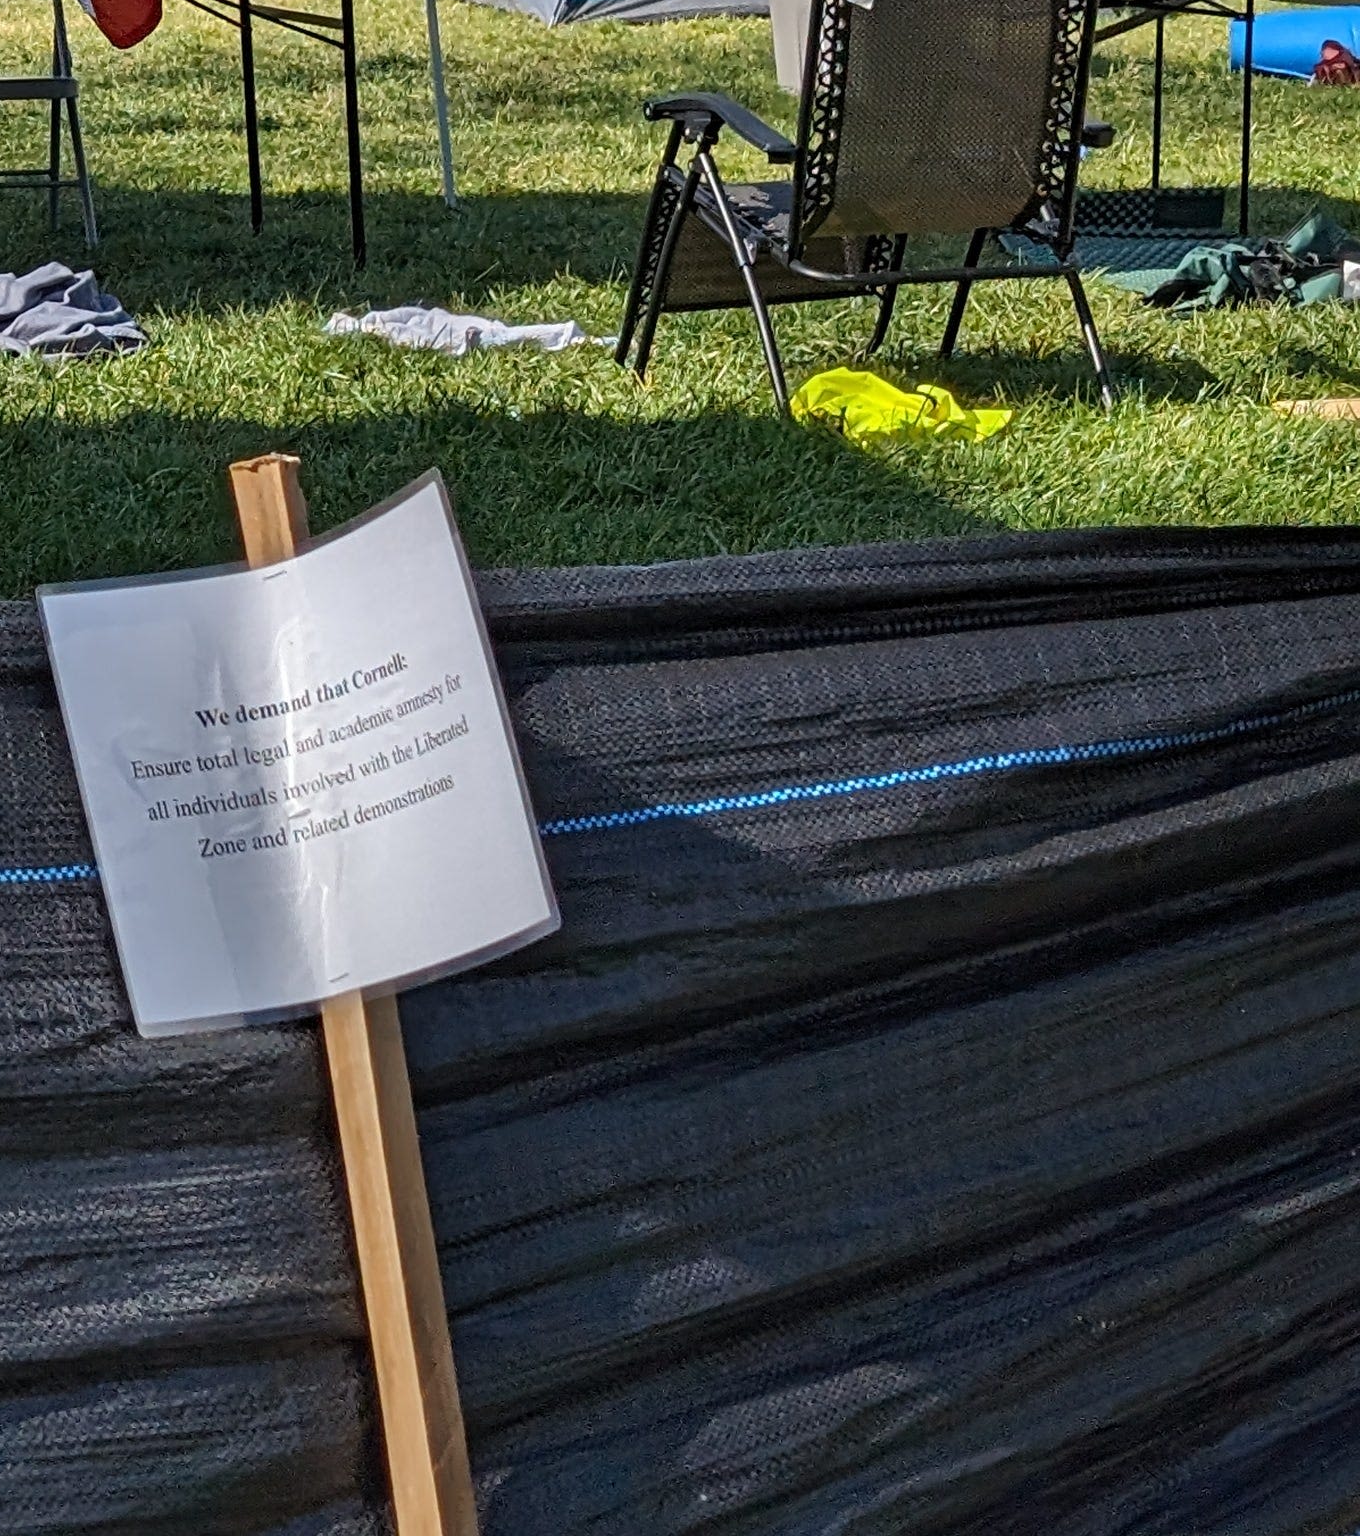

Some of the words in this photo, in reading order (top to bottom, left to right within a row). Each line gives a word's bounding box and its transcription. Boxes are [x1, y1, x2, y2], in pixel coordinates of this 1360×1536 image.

[131, 759, 192, 779] Ensure
[197, 749, 239, 771] total
[244, 739, 291, 767] legal
[296, 729, 324, 754] and
[329, 708, 393, 744] academic
[397, 685, 443, 718] amnesty
[445, 673, 462, 694] for
[194, 708, 229, 729] We
[235, 690, 311, 724] demand
[317, 678, 349, 703] that
[352, 653, 408, 690] Cornell:
[148, 800, 169, 821] all
[175, 787, 278, 817] individuals
[283, 764, 355, 800] involved
[359, 752, 390, 777] with
[391, 744, 414, 765] the
[416, 714, 470, 756] Liberated
[198, 838, 247, 858] Zone
[252, 827, 289, 850] and
[293, 810, 350, 843] related
[354, 774, 455, 825] demonstrations
